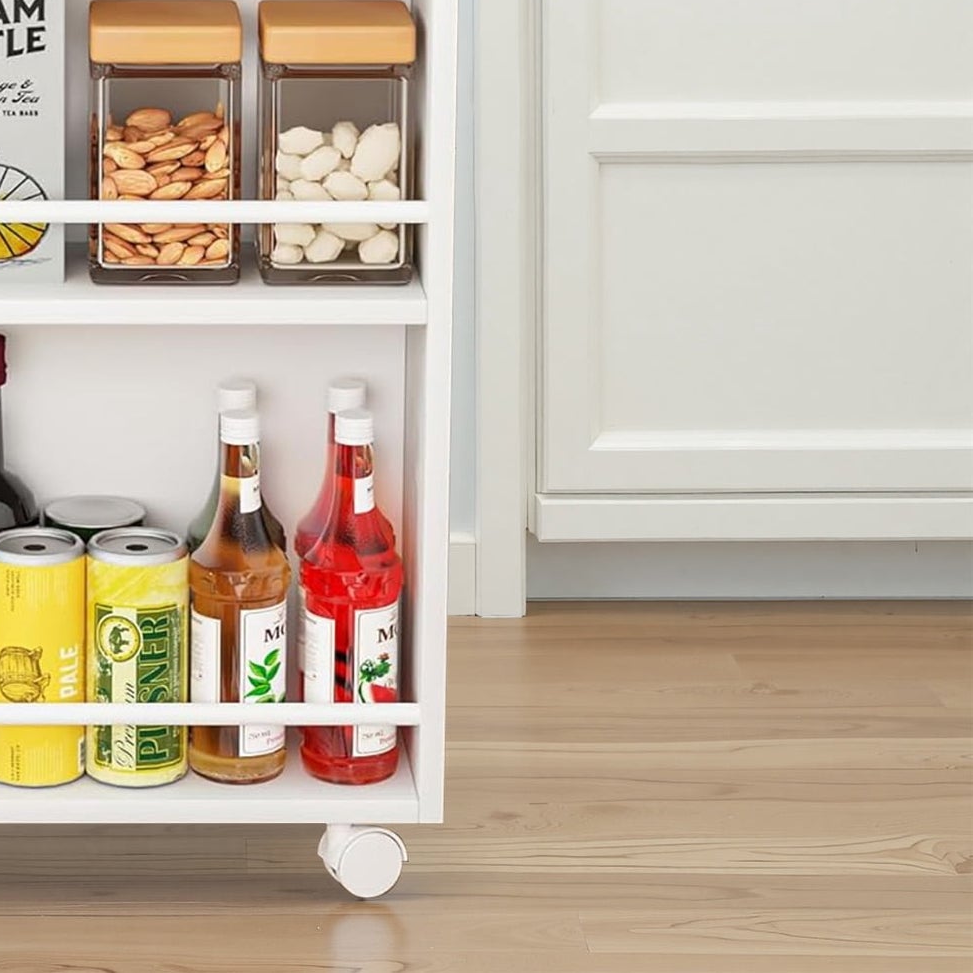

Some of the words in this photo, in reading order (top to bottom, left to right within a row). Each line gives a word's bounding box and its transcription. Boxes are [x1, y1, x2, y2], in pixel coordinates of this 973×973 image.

[11, 90, 40, 104] Tea
[20, 79, 33, 90] &
[58, 643, 79, 699] PALE
[138, 613, 170, 763] PISNER
